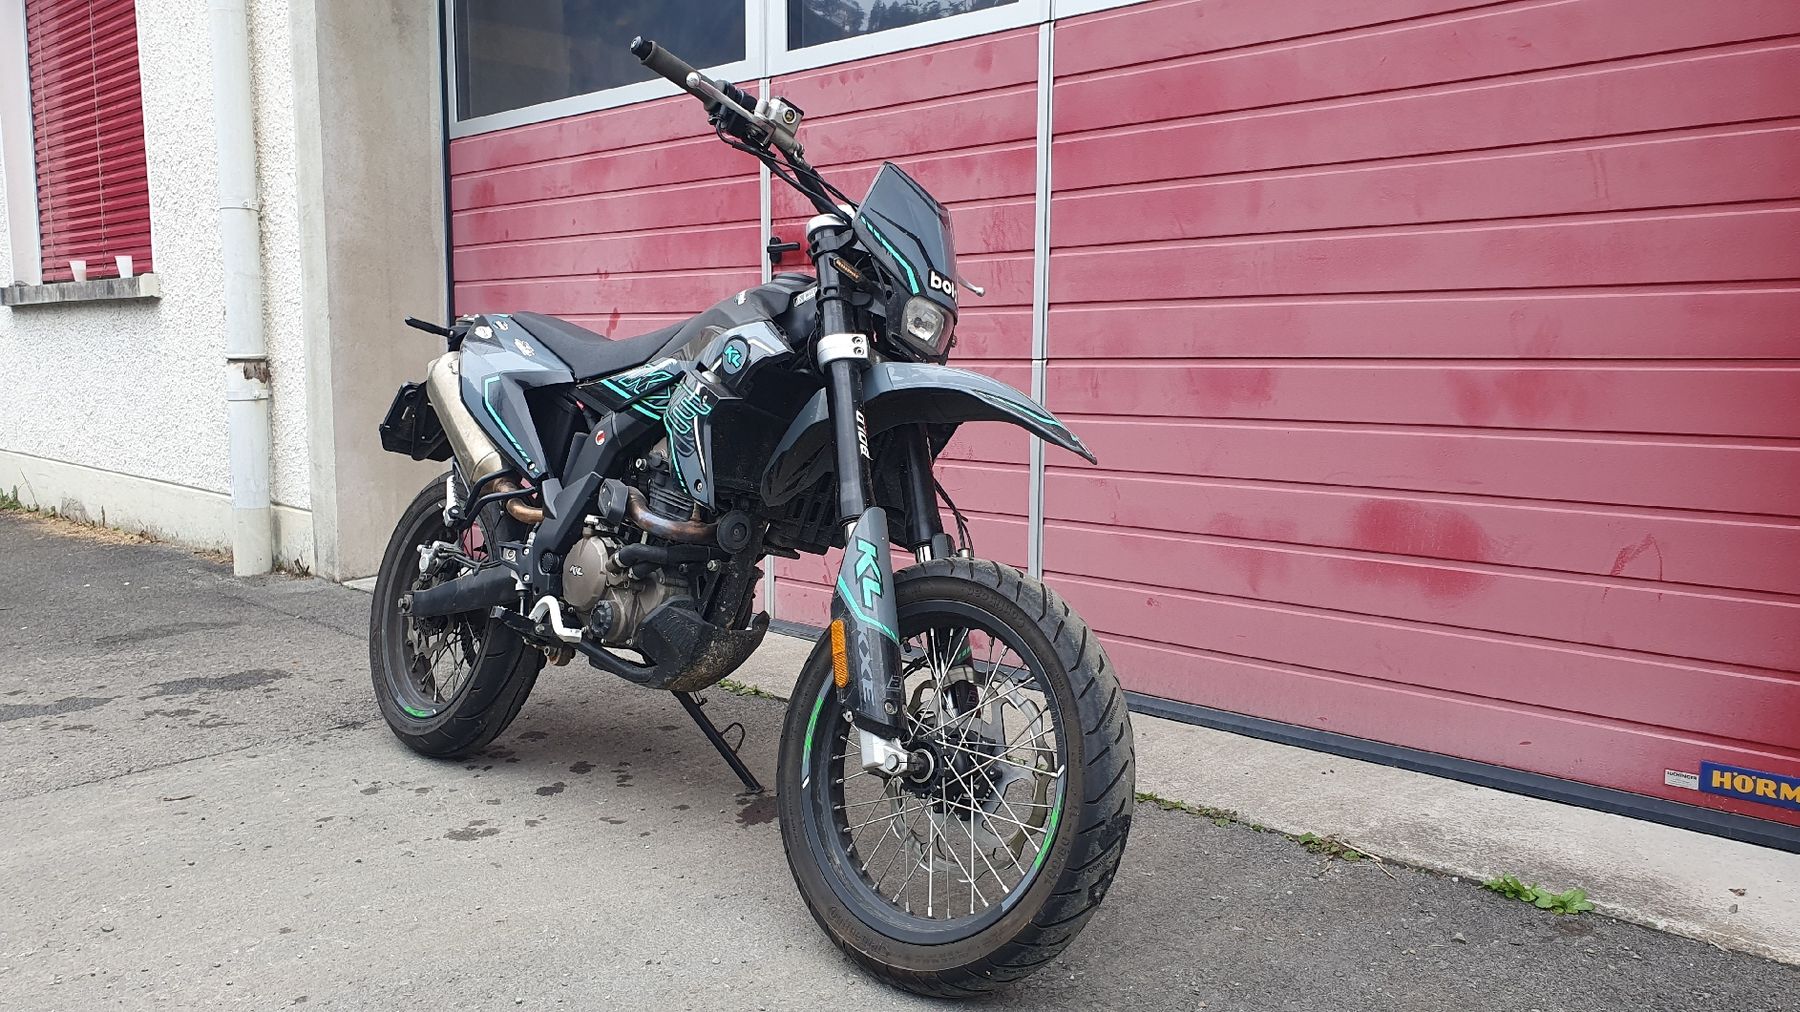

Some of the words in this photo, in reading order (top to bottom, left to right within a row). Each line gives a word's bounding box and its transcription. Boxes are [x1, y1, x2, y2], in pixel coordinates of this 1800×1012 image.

[930, 270, 957, 303] bol
[724, 345, 741, 368] KL
[856, 410, 874, 460] BOLD
[855, 537, 883, 610] KL
[1712, 769, 1800, 803] HÖRM
